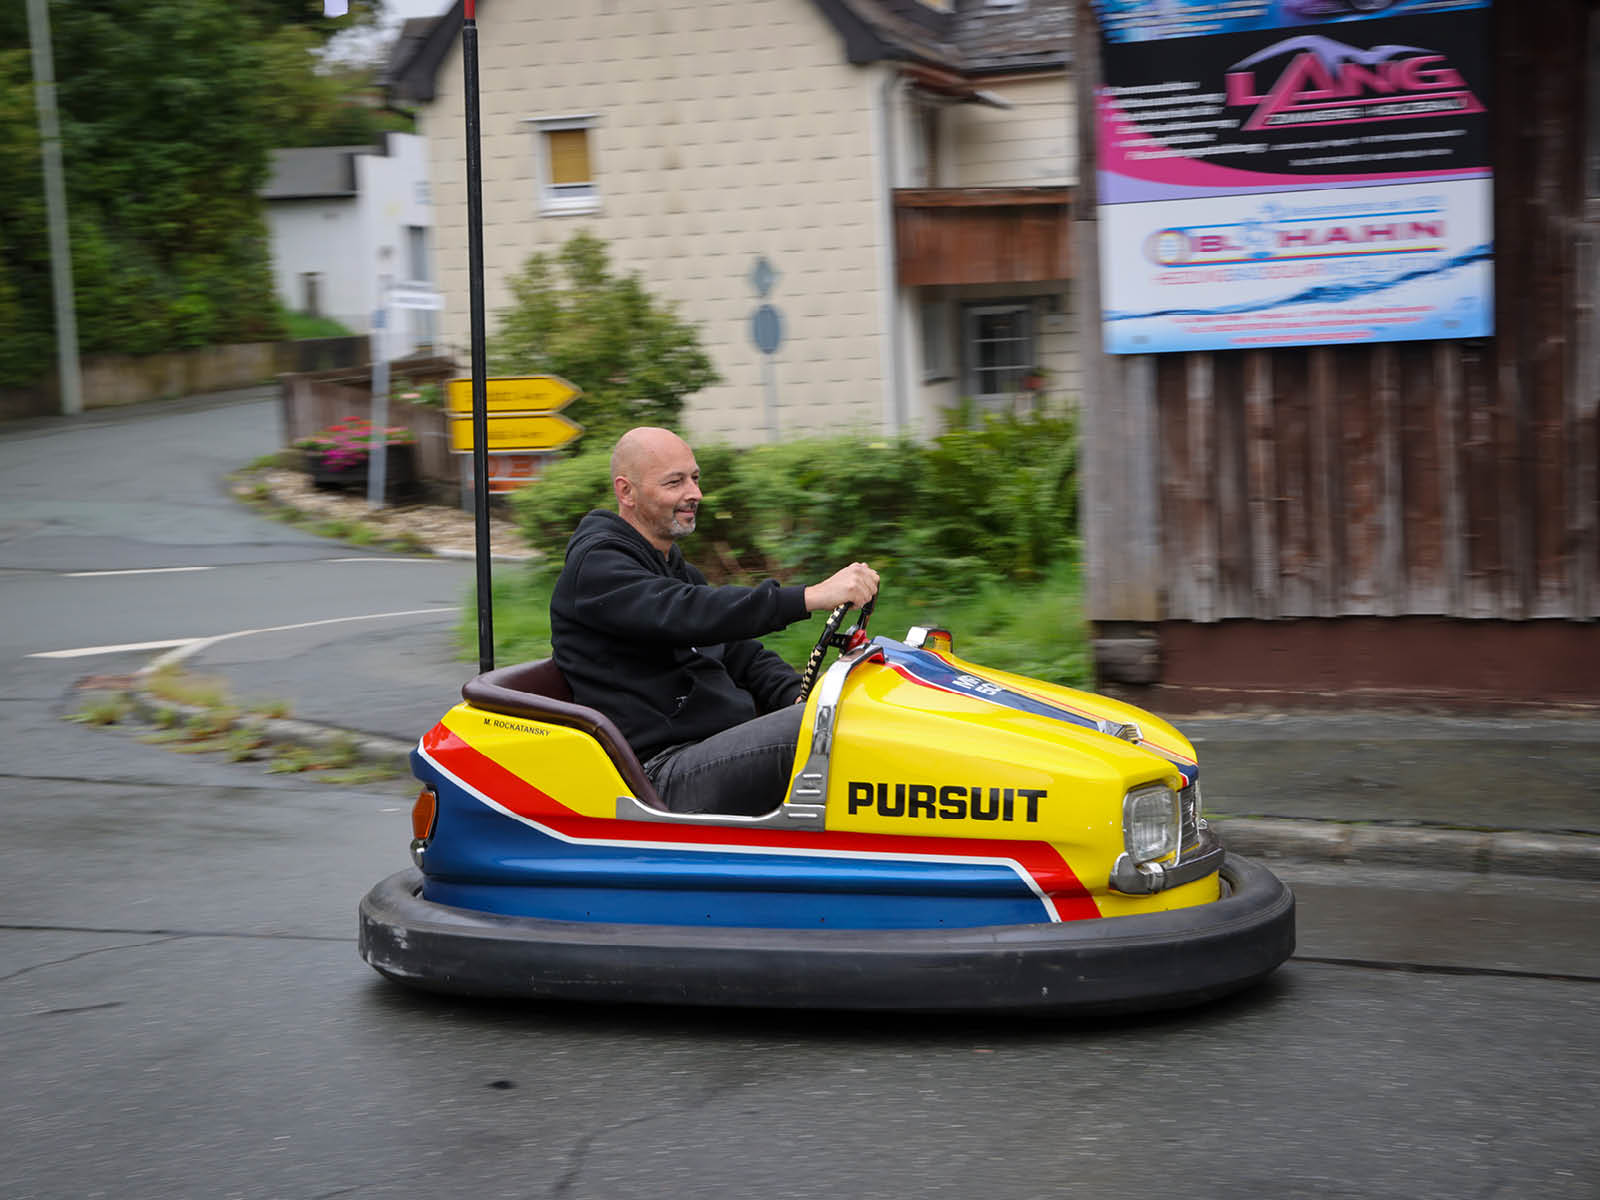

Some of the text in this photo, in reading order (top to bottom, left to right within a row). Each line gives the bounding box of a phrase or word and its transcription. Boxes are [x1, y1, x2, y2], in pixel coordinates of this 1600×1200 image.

[1224, 53, 1470, 128] LANG
[1277, 220, 1446, 250] HAHN
[493, 719, 551, 737] ROCKATANSKY
[847, 781, 1048, 823] PURSUIT
